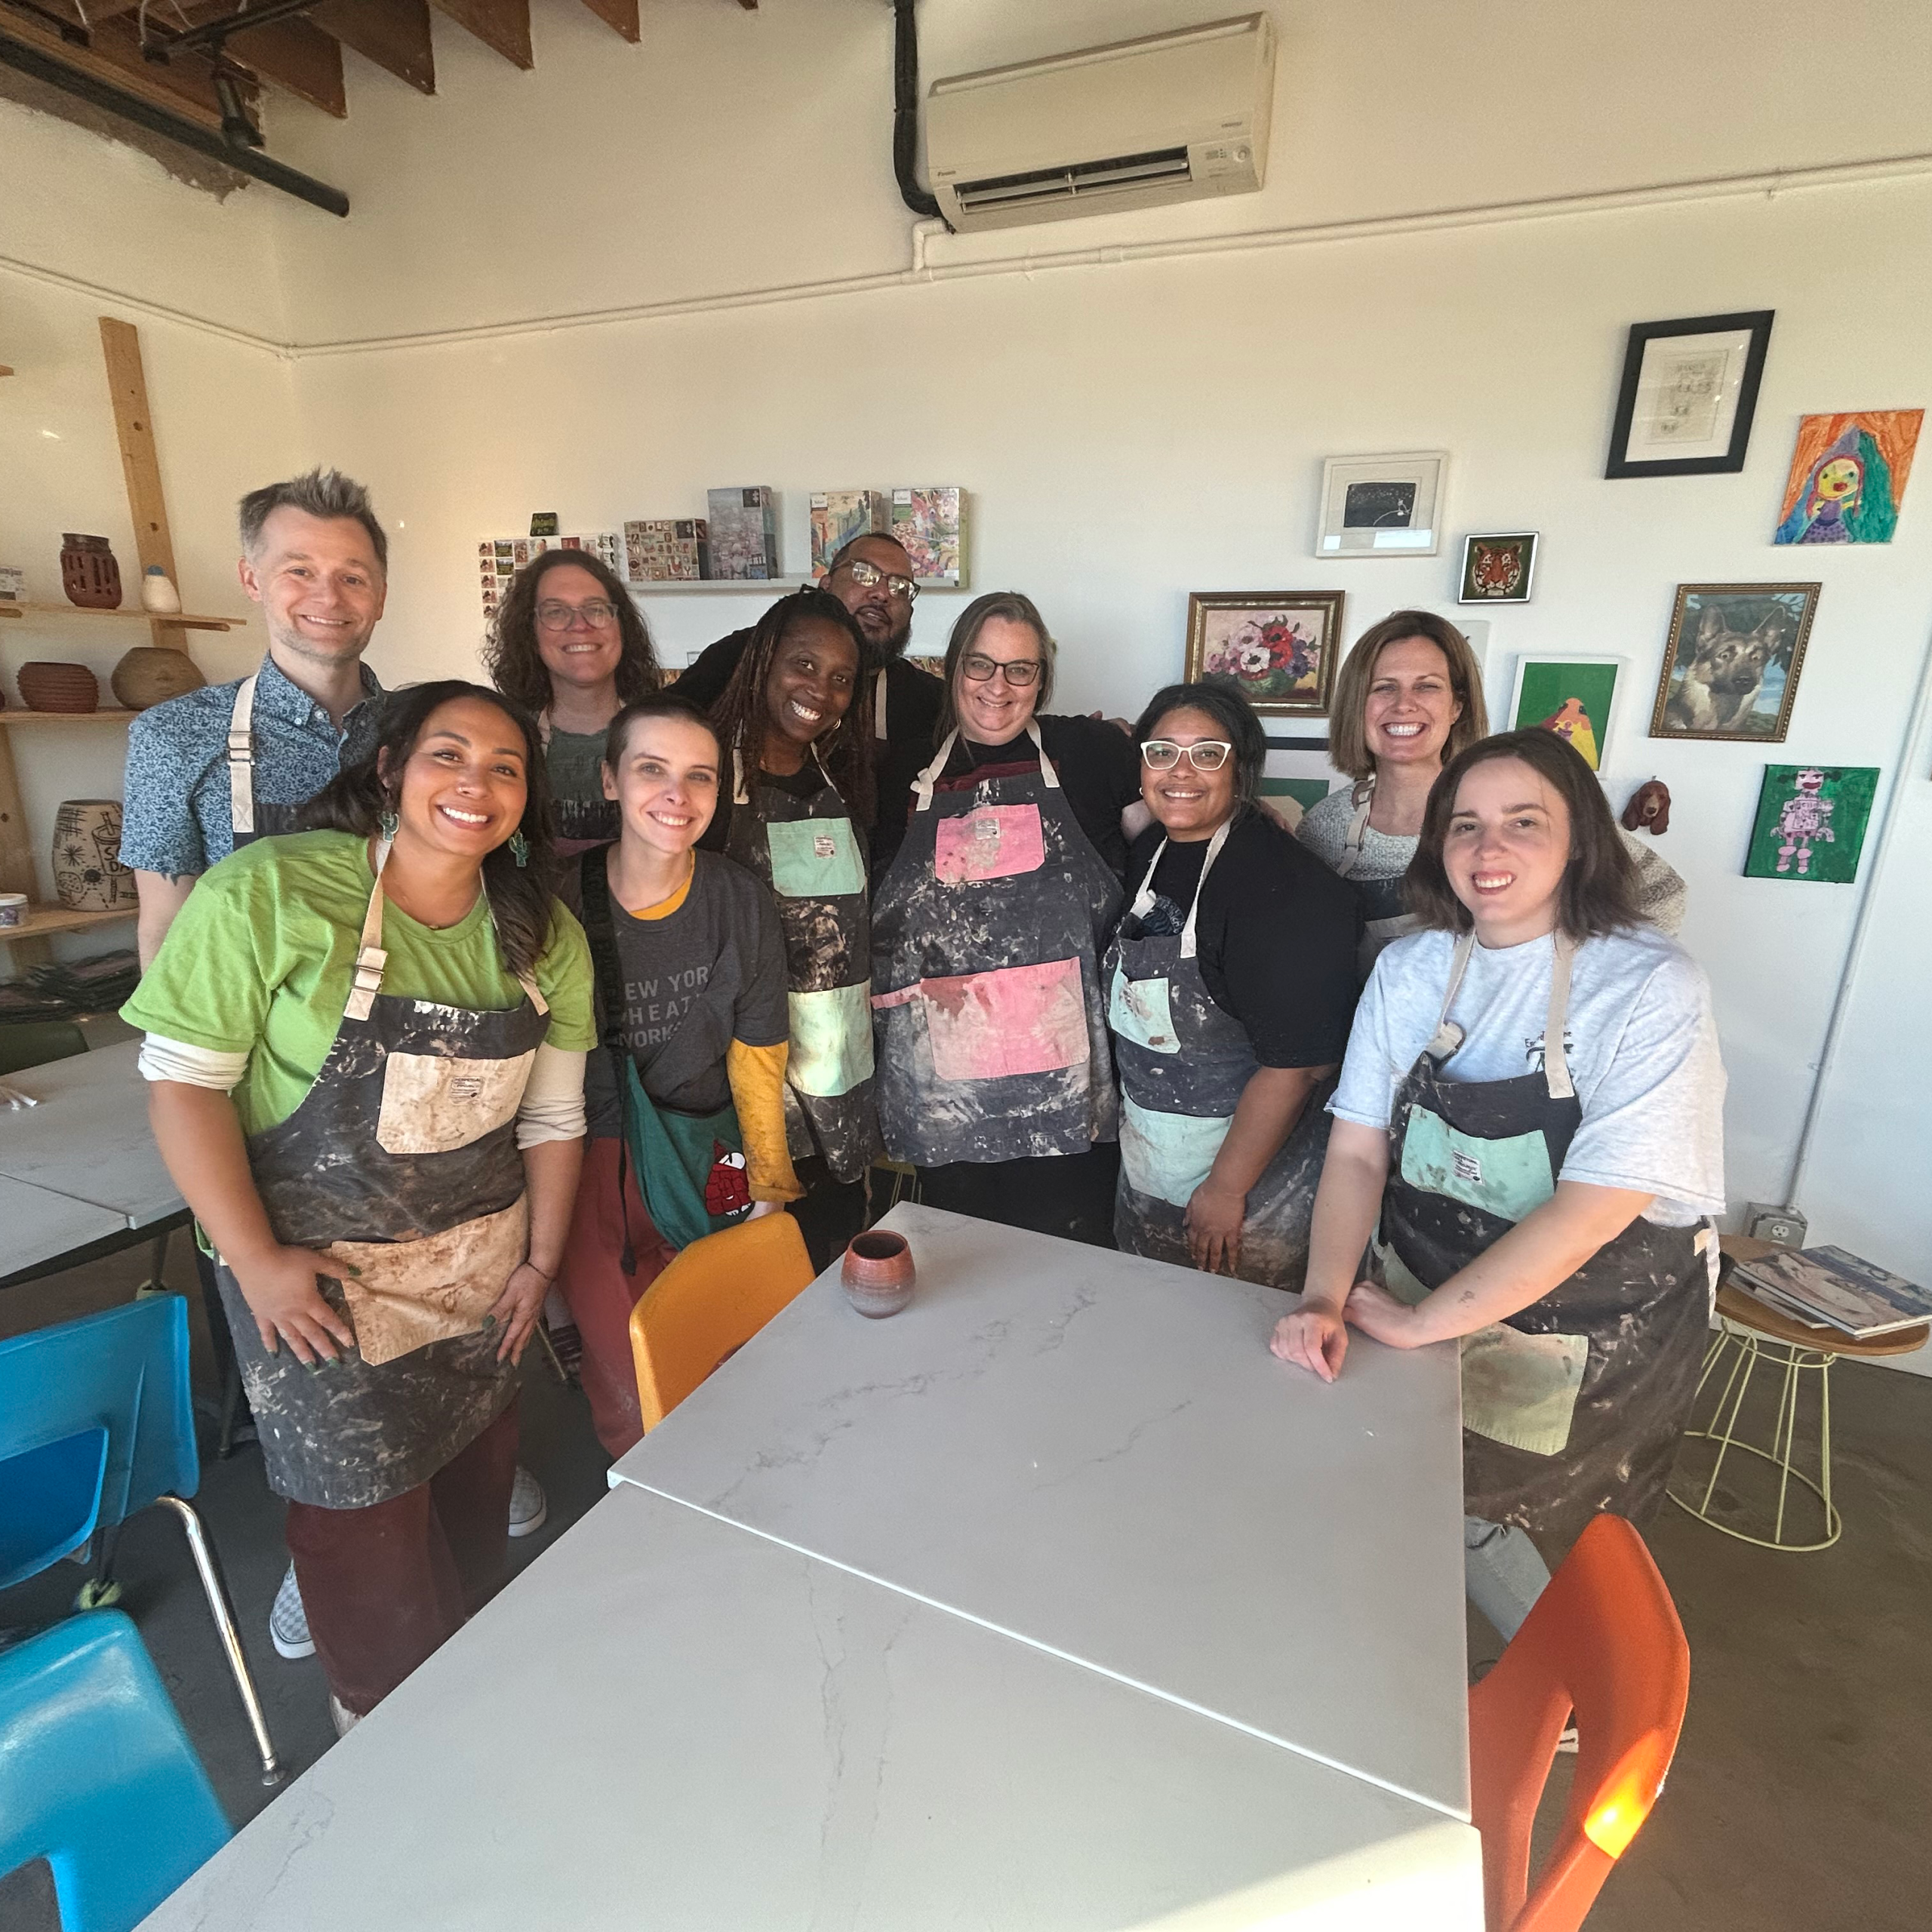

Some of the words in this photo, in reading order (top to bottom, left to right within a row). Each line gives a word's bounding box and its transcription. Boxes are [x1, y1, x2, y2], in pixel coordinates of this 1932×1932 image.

[104, 846, 120, 861] S
[624, 979, 659, 1001] EW
[668, 963, 712, 992] YOR
[621, 992, 701, 1026] HEAT
[619, 1021, 681, 1048] WORK
